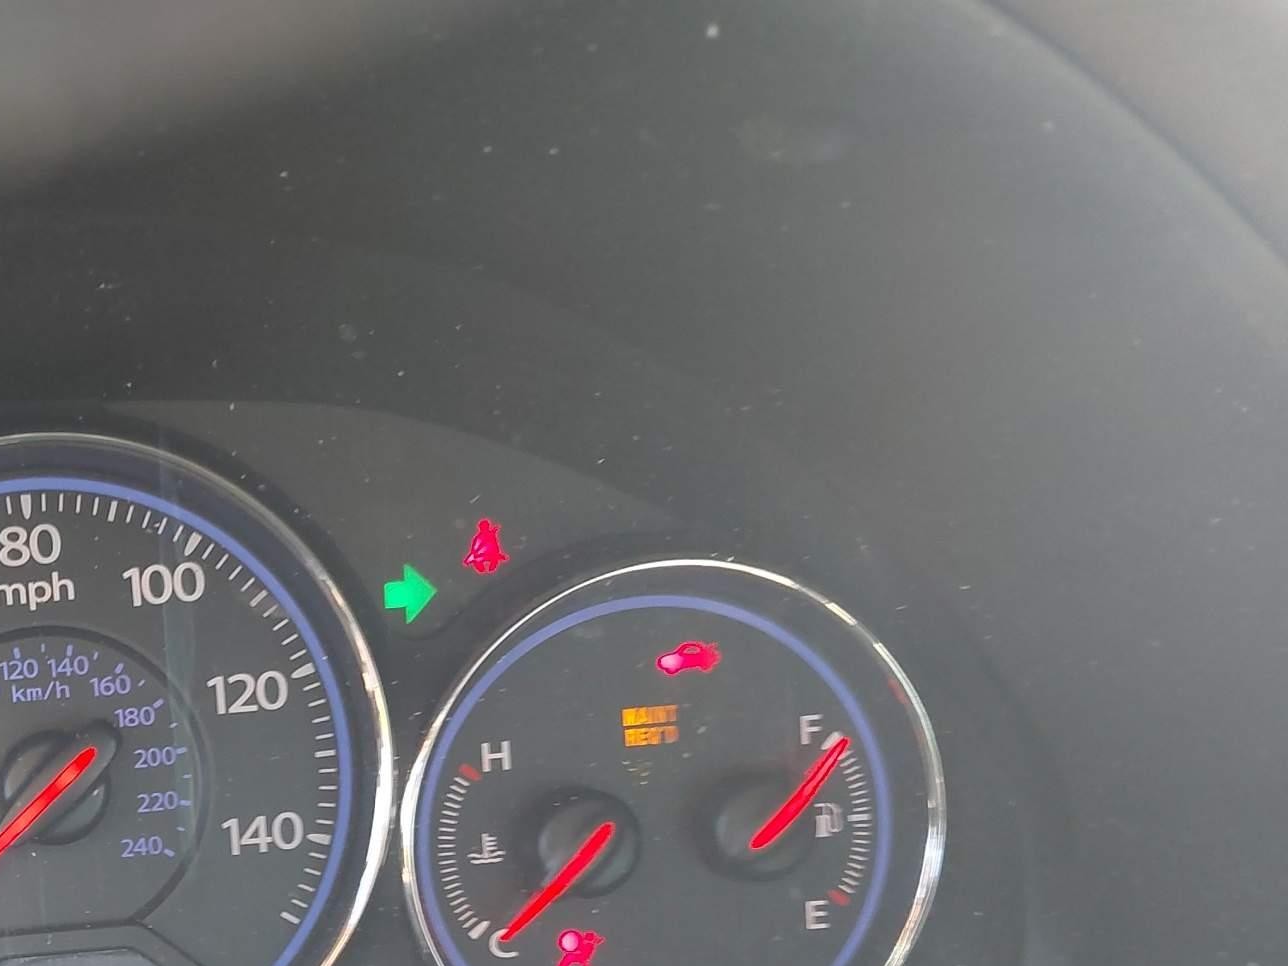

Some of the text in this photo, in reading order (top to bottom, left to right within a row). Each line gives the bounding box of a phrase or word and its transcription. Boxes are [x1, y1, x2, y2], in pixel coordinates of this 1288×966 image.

[123, 562, 205, 607] 100
[0, 660, 39, 680] 120
[48, 655, 89, 677] 140
[11, 680, 71, 702] km/h
[90, 674, 131, 697] 160
[207, 670, 289, 714] 120
[117, 705, 156, 728] 180
[799, 714, 822, 744] F
[134, 747, 176, 769] 200
[480, 741, 512, 771] H
[137, 792, 178, 812] 220
[222, 811, 304, 855] 140
[121, 836, 162, 857] 240
[805, 900, 829, 930] E
[488, 929, 520, 958] C
